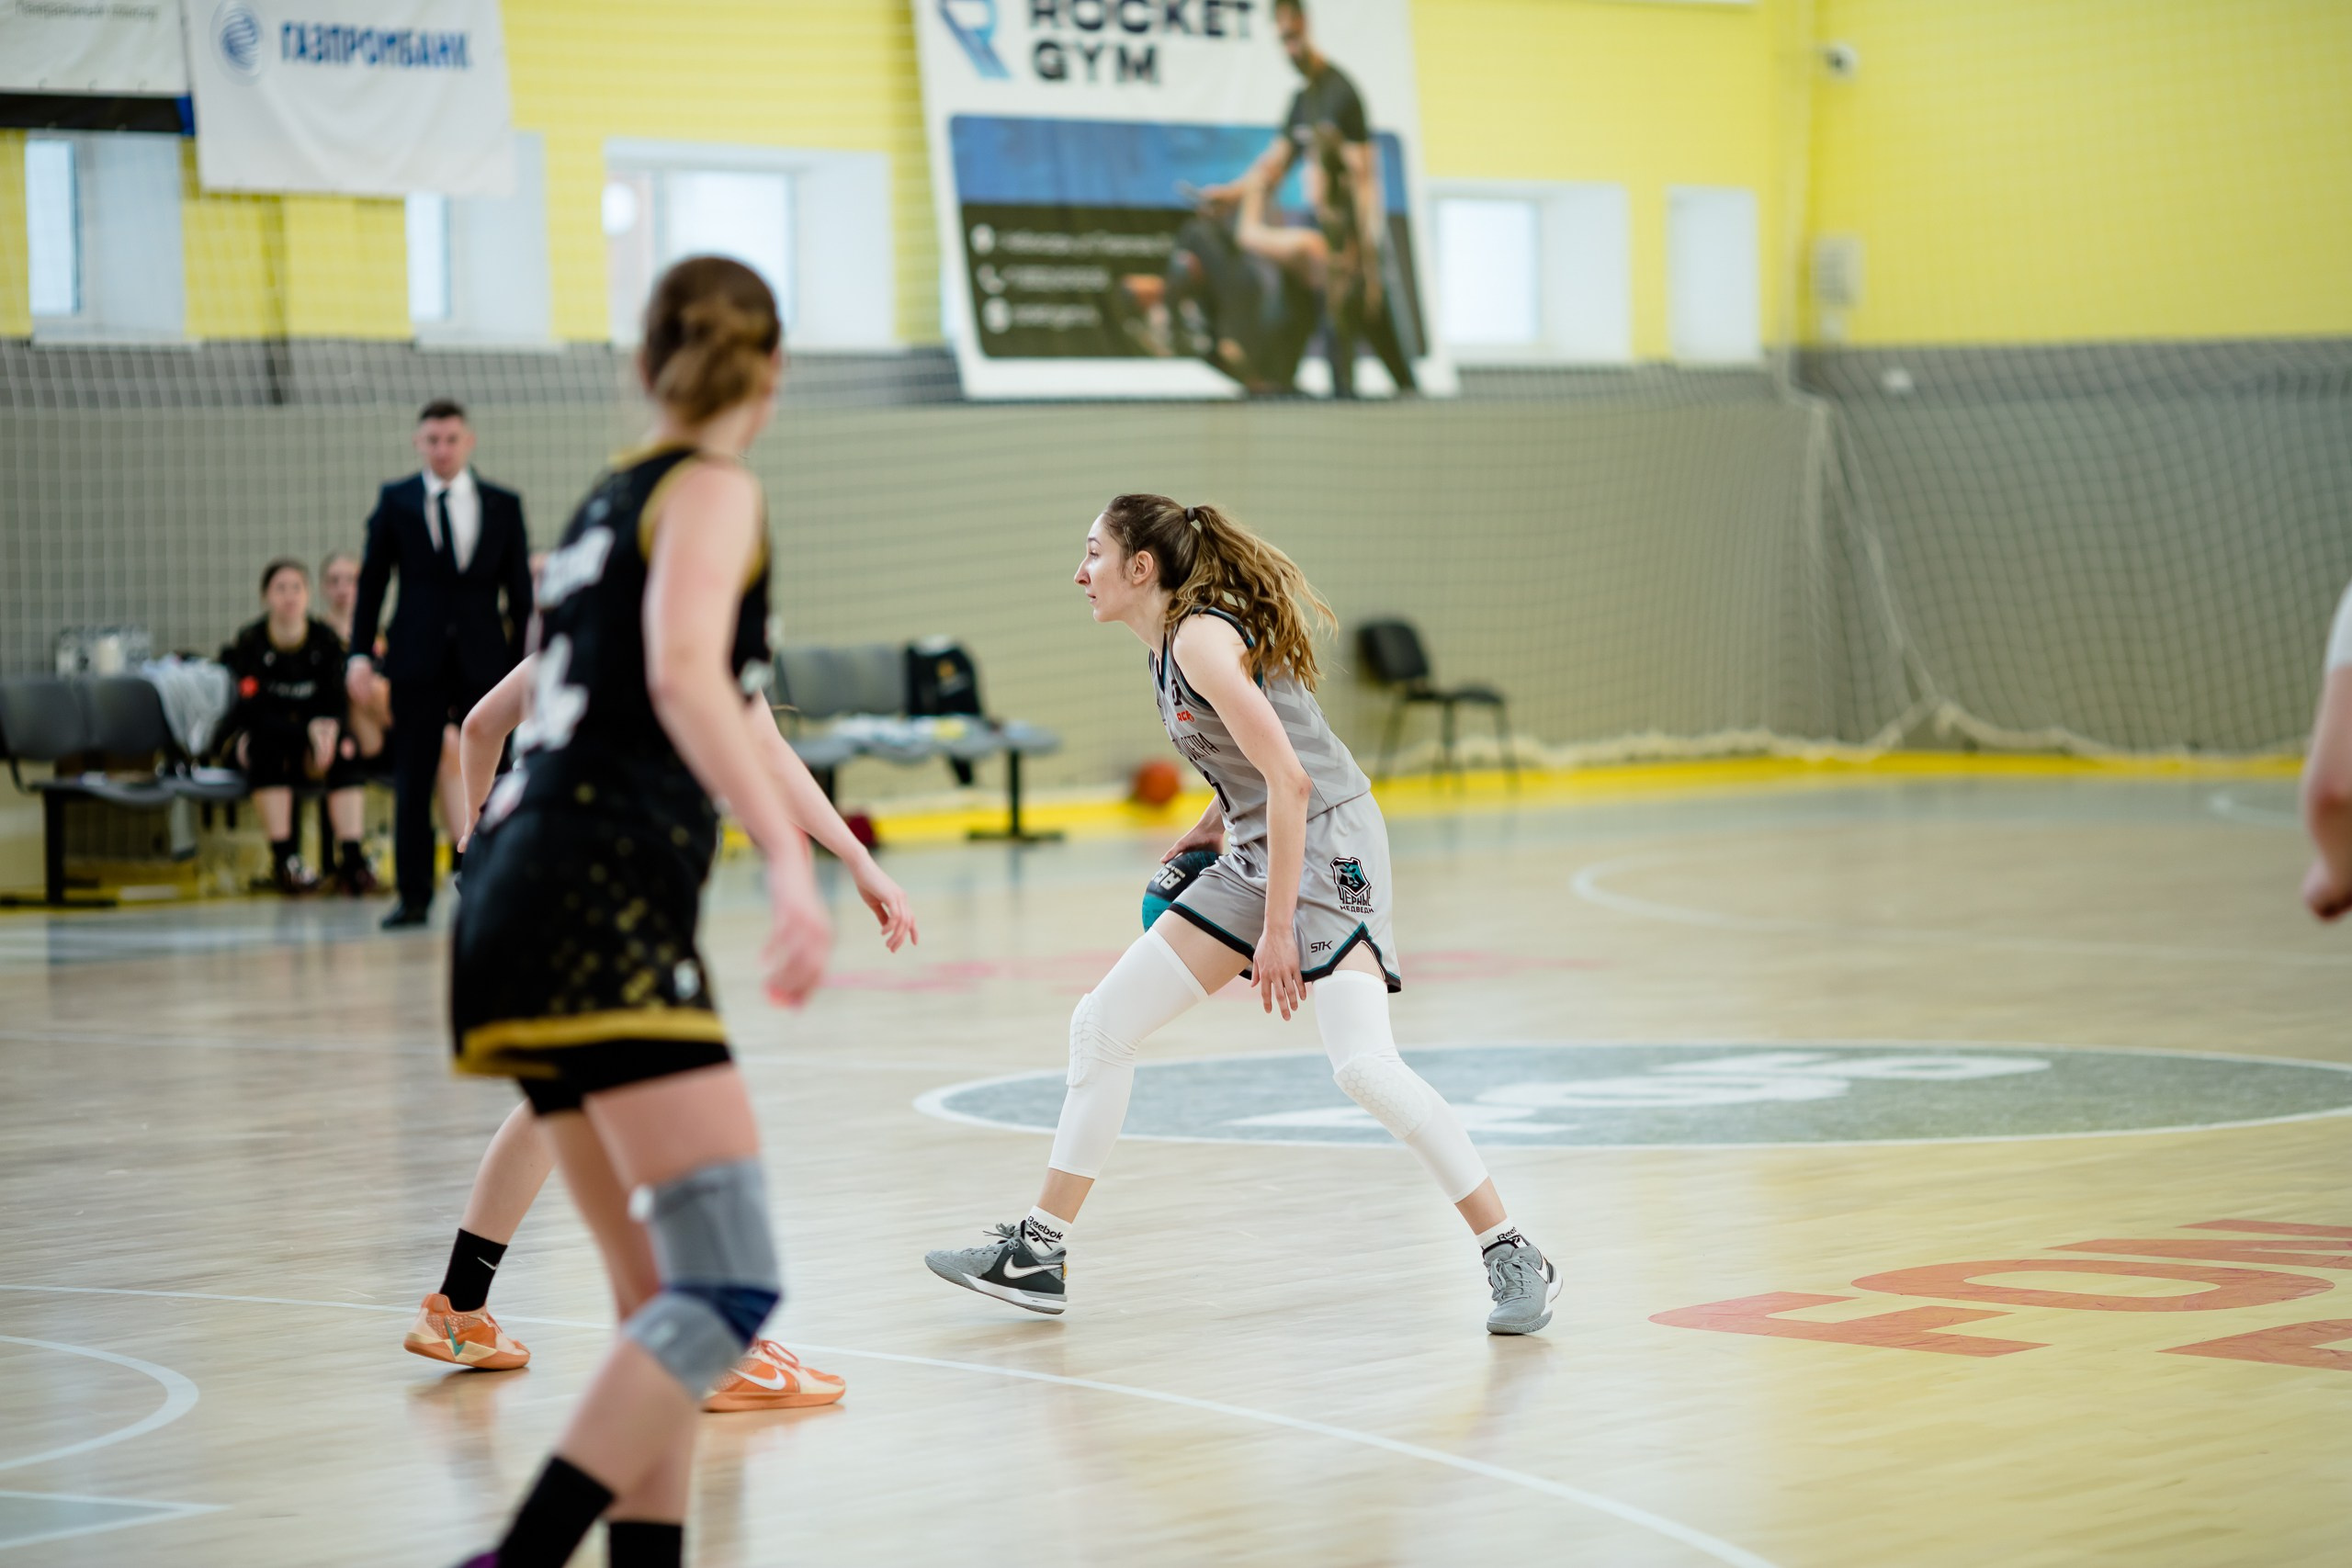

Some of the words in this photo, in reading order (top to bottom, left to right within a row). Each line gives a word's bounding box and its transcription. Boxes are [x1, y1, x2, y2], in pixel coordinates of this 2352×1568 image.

[280, 20, 471, 70] ГАЗПРОМБАНК
[1032, 40, 1160, 85] GYM
[1339, 904, 1374, 915] МЕДВЕДИ
[1310, 940, 1333, 953] STK
[1027, 1215, 1064, 1241] Reebok
